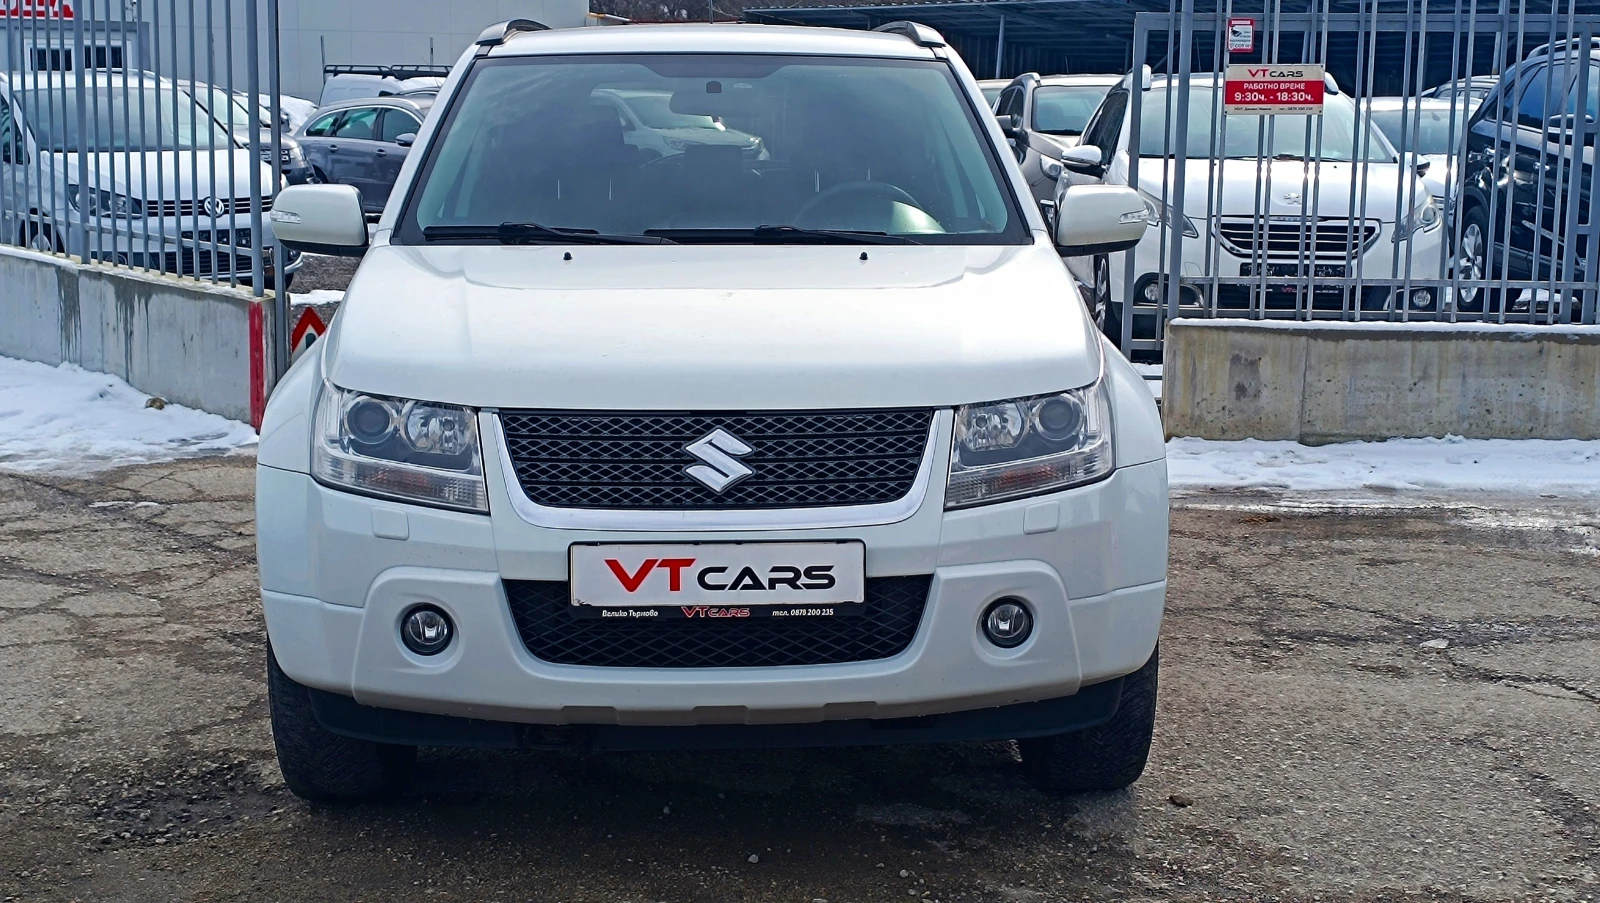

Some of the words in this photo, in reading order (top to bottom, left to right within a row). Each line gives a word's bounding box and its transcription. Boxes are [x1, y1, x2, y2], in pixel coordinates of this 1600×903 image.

[601, 609, 628, 618] Велико
[628, 608, 659, 619] Търново
[807, 608, 821, 617] 200
[821, 607, 834, 616] 235
